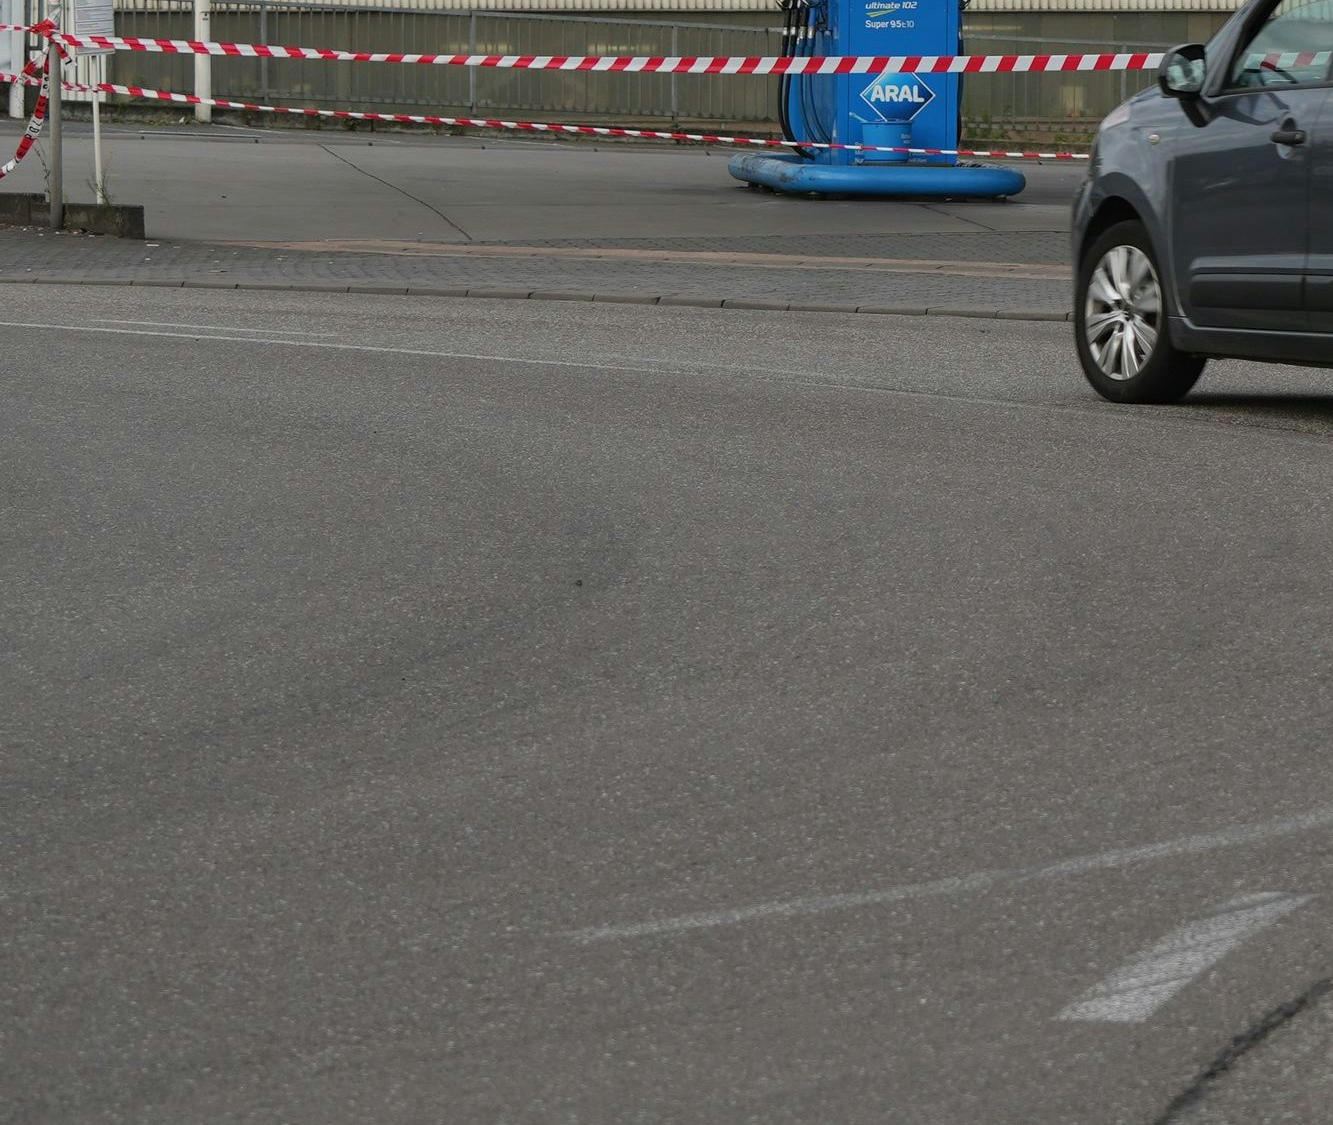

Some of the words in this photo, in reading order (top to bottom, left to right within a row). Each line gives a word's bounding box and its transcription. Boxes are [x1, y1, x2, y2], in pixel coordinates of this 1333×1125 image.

[865, 1, 901, 9] ultimate
[902, 1, 918, 9] 102
[865, 20, 889, 29] Super
[870, 84, 926, 103] ARAL
